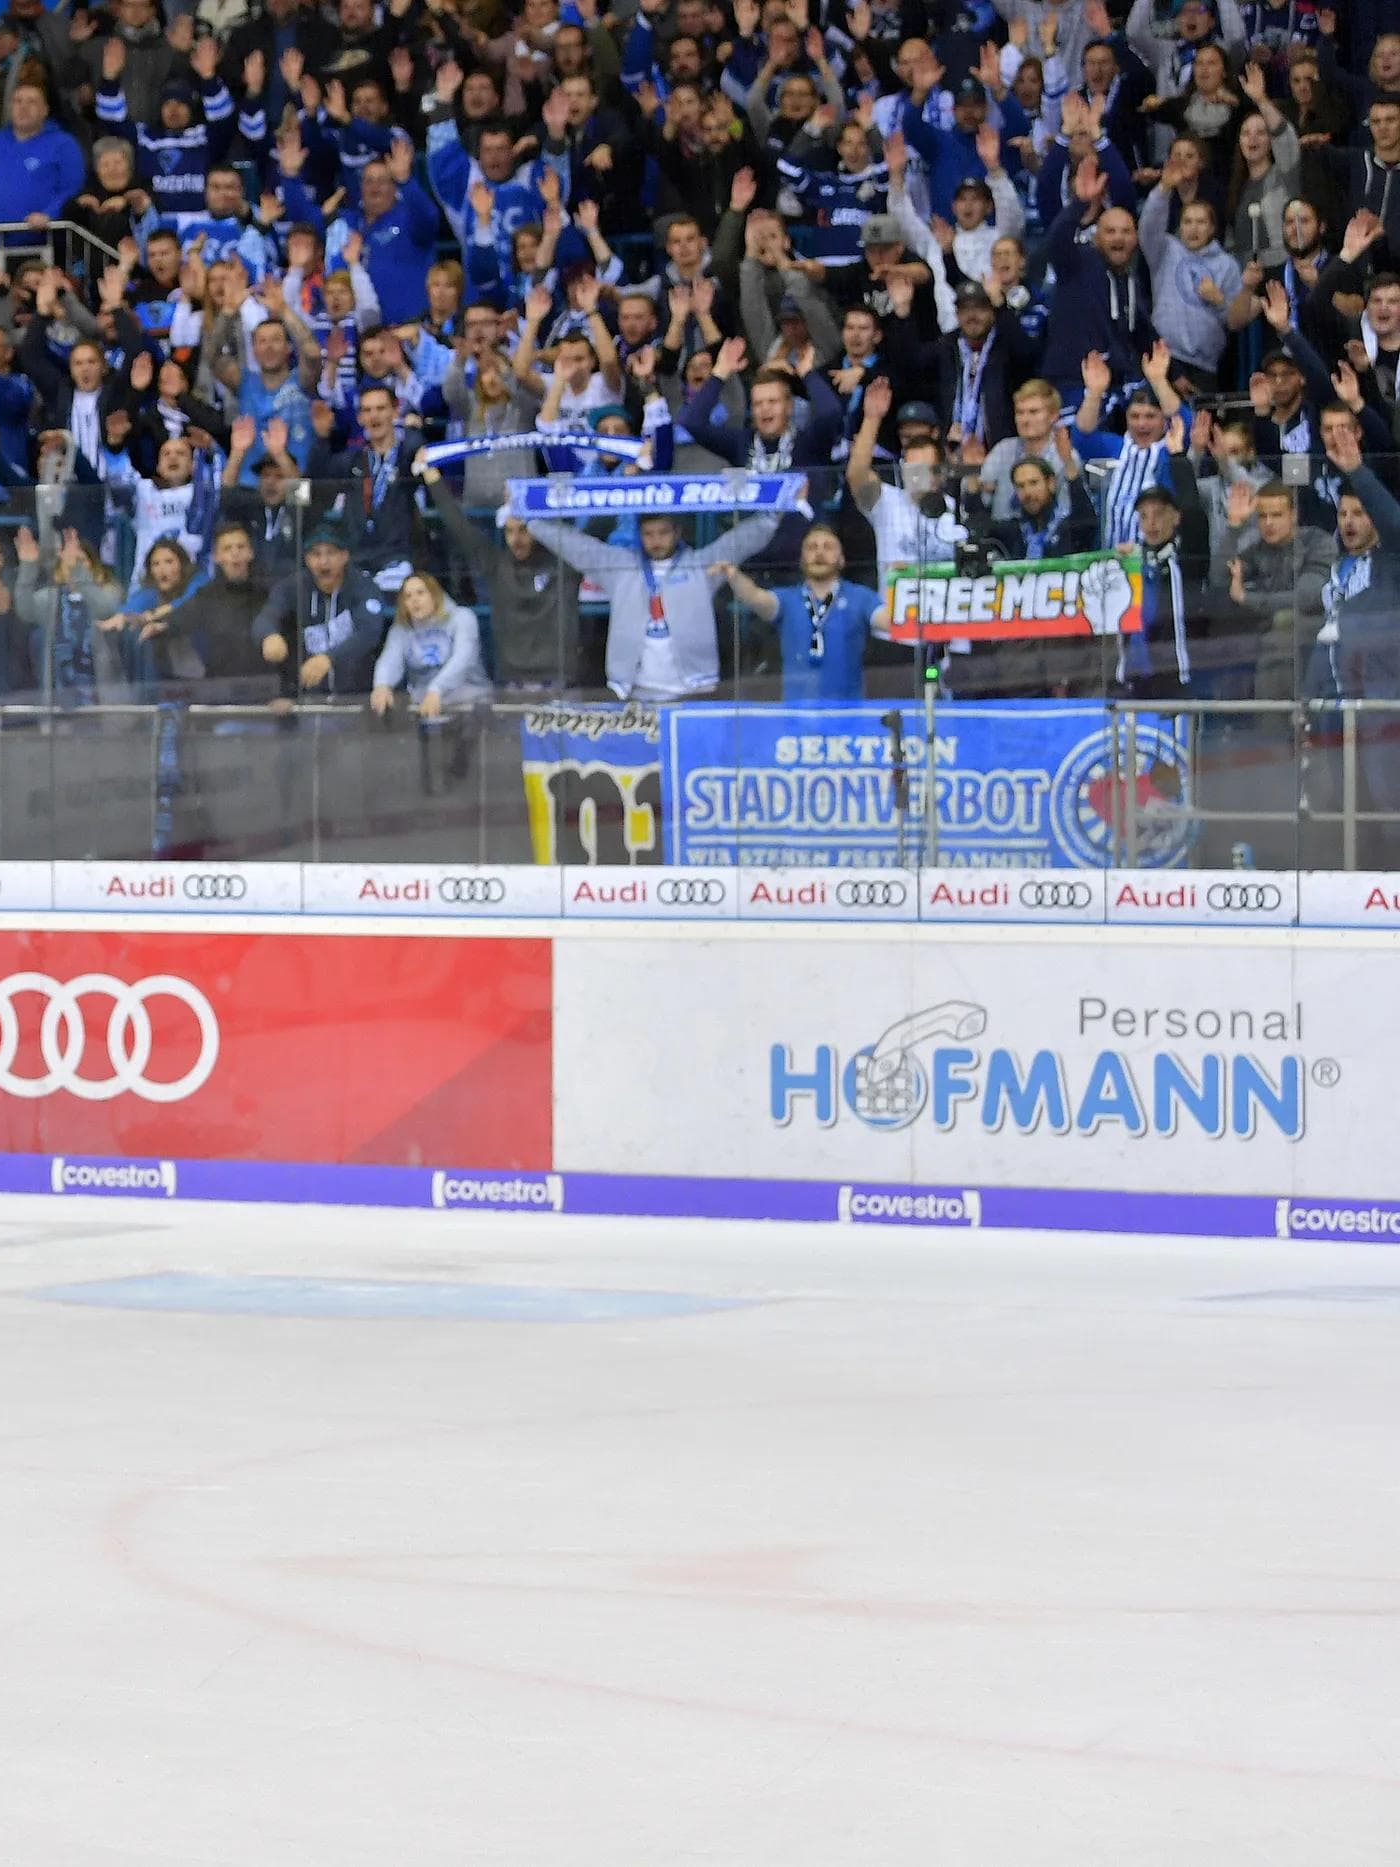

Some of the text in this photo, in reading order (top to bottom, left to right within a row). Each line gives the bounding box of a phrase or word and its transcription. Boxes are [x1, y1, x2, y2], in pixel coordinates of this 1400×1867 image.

[893, 570, 1080, 626] FREE MC!
[106, 875, 176, 899] Audi
[358, 877, 431, 901] Audi
[573, 879, 648, 903] Audi
[749, 880, 827, 905] Audi
[930, 882, 1009, 906] Audi
[1114, 884, 1197, 909] Audi
[1079, 997, 1303, 1042] Personal
[769, 1042, 1306, 1141] HOFMANN
